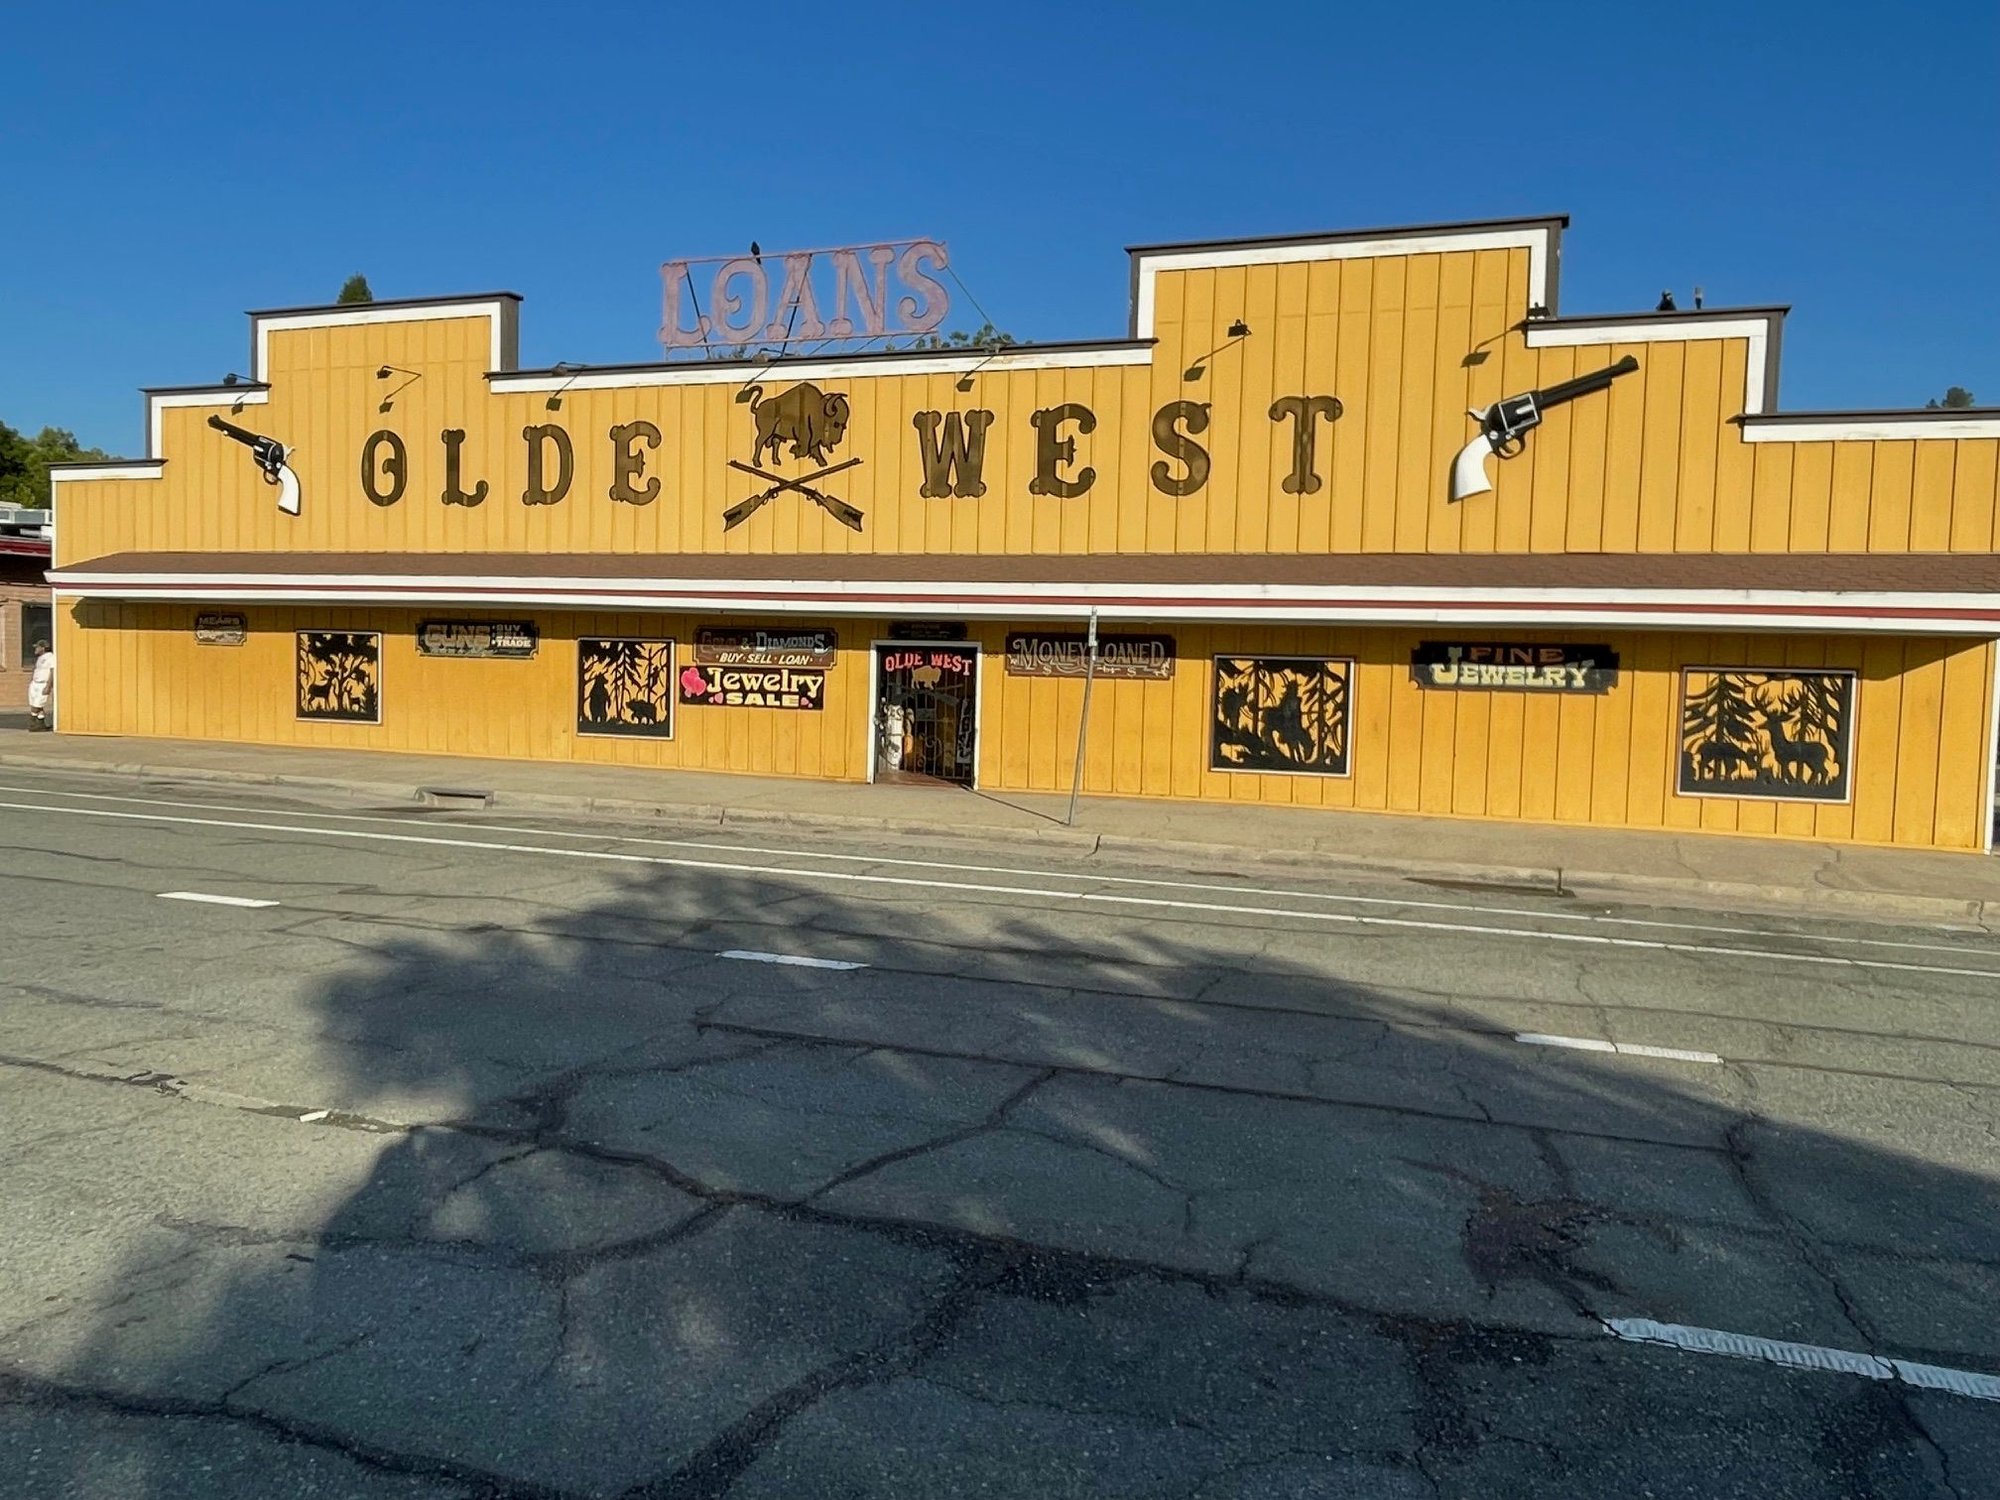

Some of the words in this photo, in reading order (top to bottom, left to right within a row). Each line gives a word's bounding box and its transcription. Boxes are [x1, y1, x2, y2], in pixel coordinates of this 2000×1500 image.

[659, 240, 949, 345] LOANS
[361, 420, 663, 507] OLDE
[913, 396, 1343, 499] WEST
[425, 625, 490, 647] GUNS
[496, 639, 531, 648] TRADE
[756, 632, 830, 653] DIAMONDS
[719, 653, 743, 663] BUY
[747, 654, 772, 664] SELL
[779, 655, 809, 665] LOAN
[885, 652, 924, 673] OLDE
[930, 653, 973, 676] WEST
[1012, 638, 1087, 667] MONEY
[1469, 647, 1565, 664] FINE
[1431, 647, 1595, 688] JEWELRY
[706, 667, 823, 697] Jewelry
[726, 693, 801, 707] SALE
